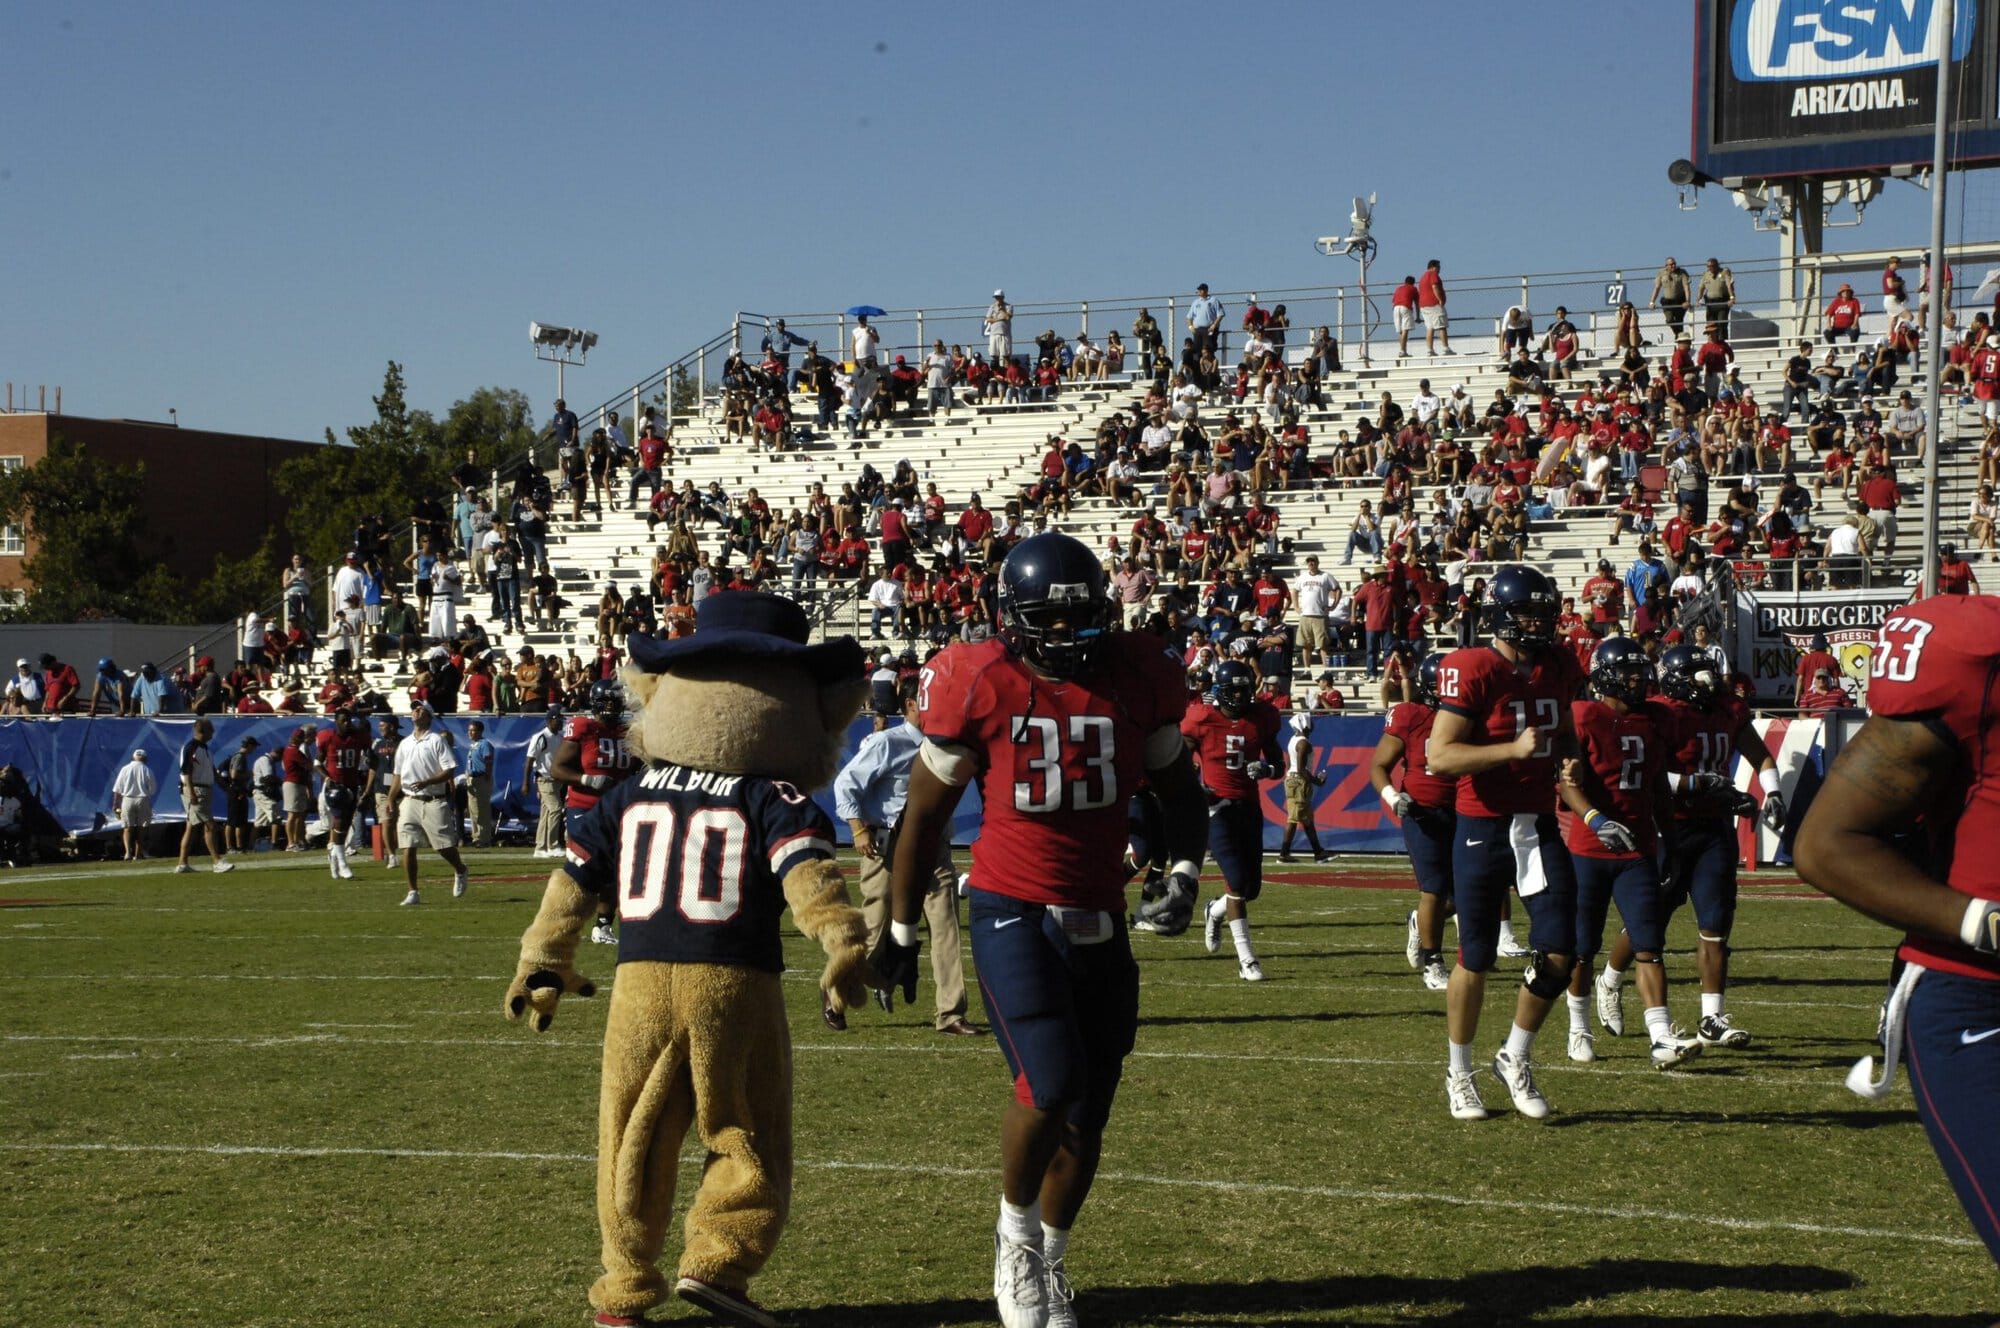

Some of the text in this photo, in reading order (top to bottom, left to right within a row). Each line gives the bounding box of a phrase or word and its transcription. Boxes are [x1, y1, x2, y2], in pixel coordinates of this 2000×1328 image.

[1767, 0, 1935, 67] FSN
[1791, 79, 1905, 117] ARIZONA
[1608, 284, 1624, 304] 27
[1228, 595, 1239, 612] 7
[1761, 603, 1903, 632] BRUEGGER'
[1790, 631, 1872, 648] BAK FRESH
[1439, 667, 1459, 697] 12
[1508, 698, 1559, 758] 12
[1011, 715, 1117, 812] 33
[1226, 735, 1245, 770] 5
[1619, 735, 1645, 790] 2
[1696, 732, 1729, 775] 10
[617, 801, 749, 923] 00
